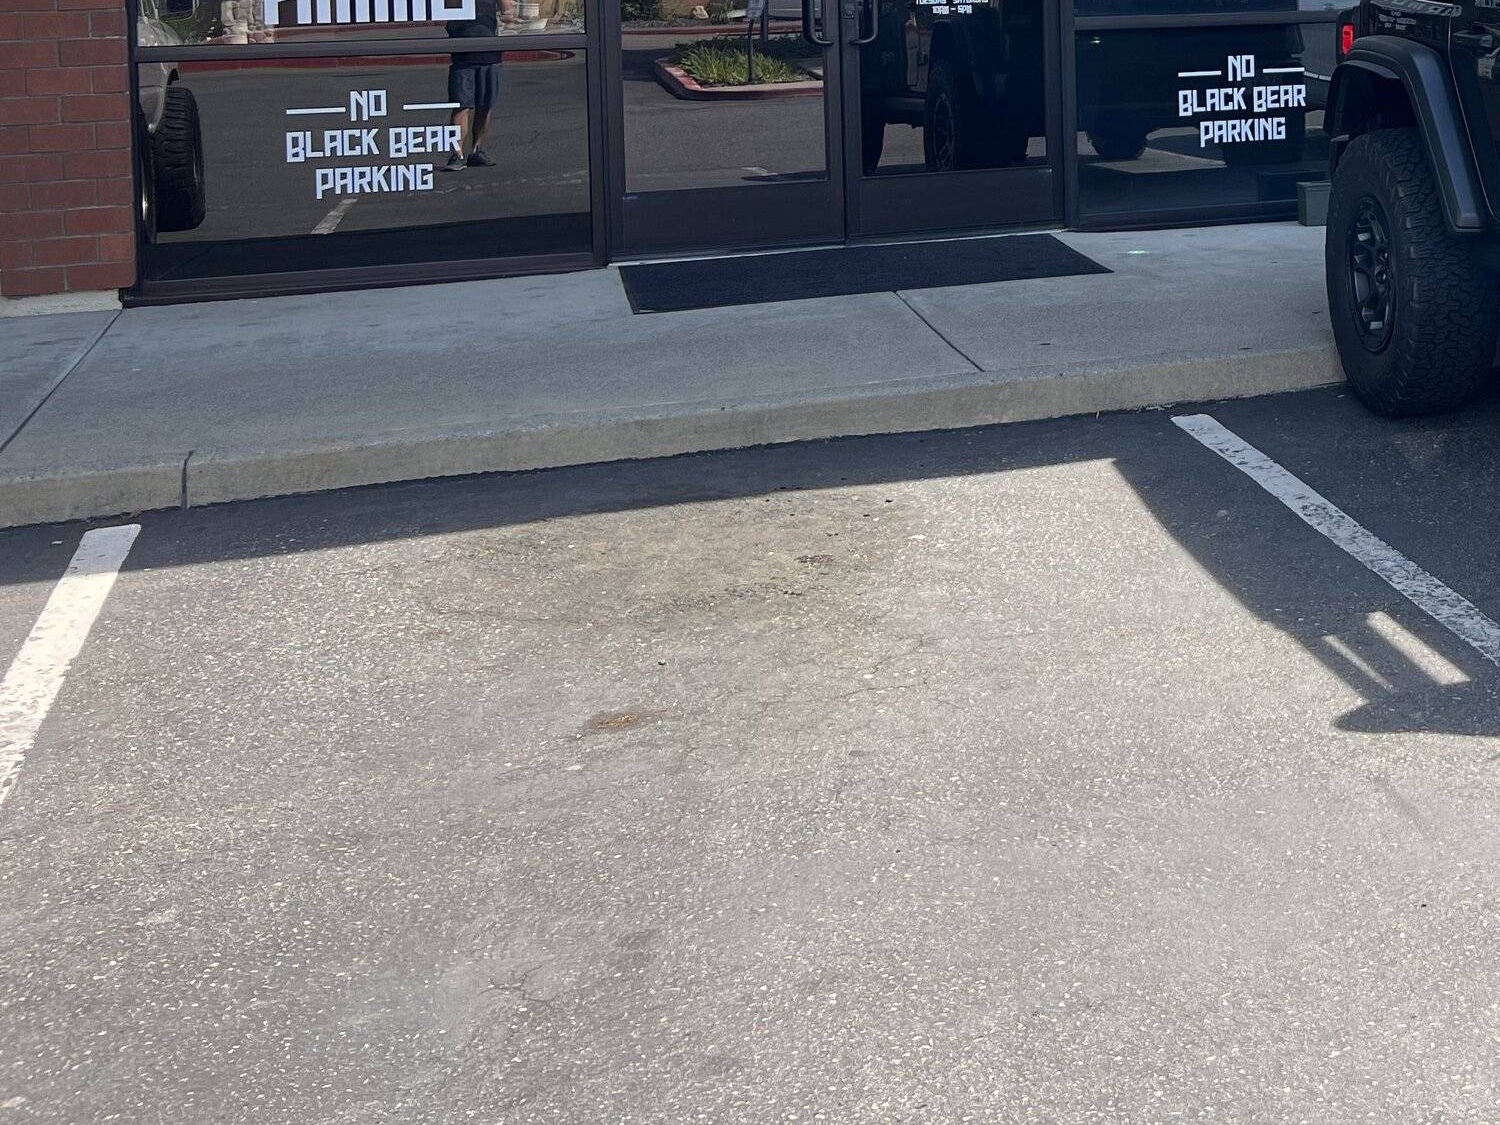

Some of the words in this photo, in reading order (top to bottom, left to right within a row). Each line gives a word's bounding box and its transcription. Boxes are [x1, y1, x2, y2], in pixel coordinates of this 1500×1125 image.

[1227, 54, 1255, 82] NO
[349, 89, 387, 122] NO
[1178, 86, 1246, 117] BLACK
[1253, 84, 1306, 114] BEAR
[286, 128, 379, 163] BLACK
[389, 124, 462, 159] BEAR
[1200, 117, 1286, 148] PARKING
[315, 163, 434, 200] PARKING
